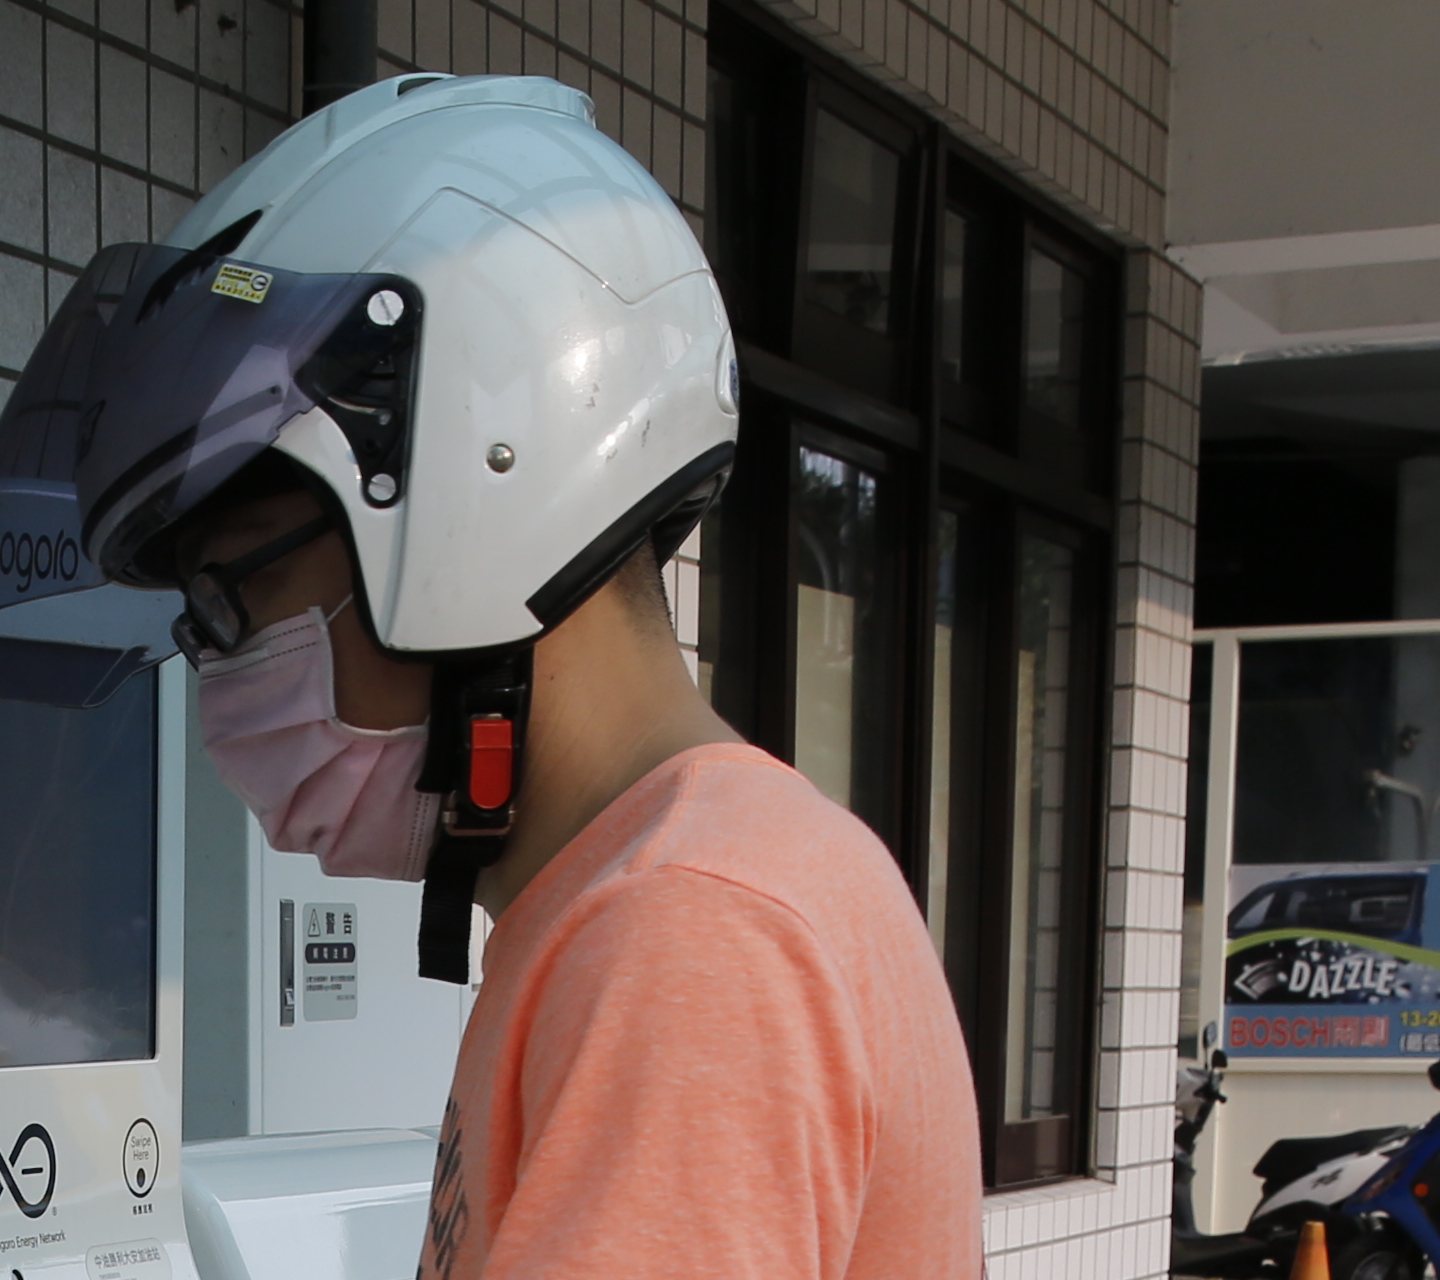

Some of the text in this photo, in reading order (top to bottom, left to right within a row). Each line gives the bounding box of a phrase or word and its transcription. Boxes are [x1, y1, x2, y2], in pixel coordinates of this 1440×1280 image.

[1288, 959, 1398, 999] DAZZLE
[130, 1135, 151, 1150] Swipe
[133, 1150, 149, 1161] Here
[16, 1234, 39, 1251] Energy
[39, 1229, 66, 1246] Network
